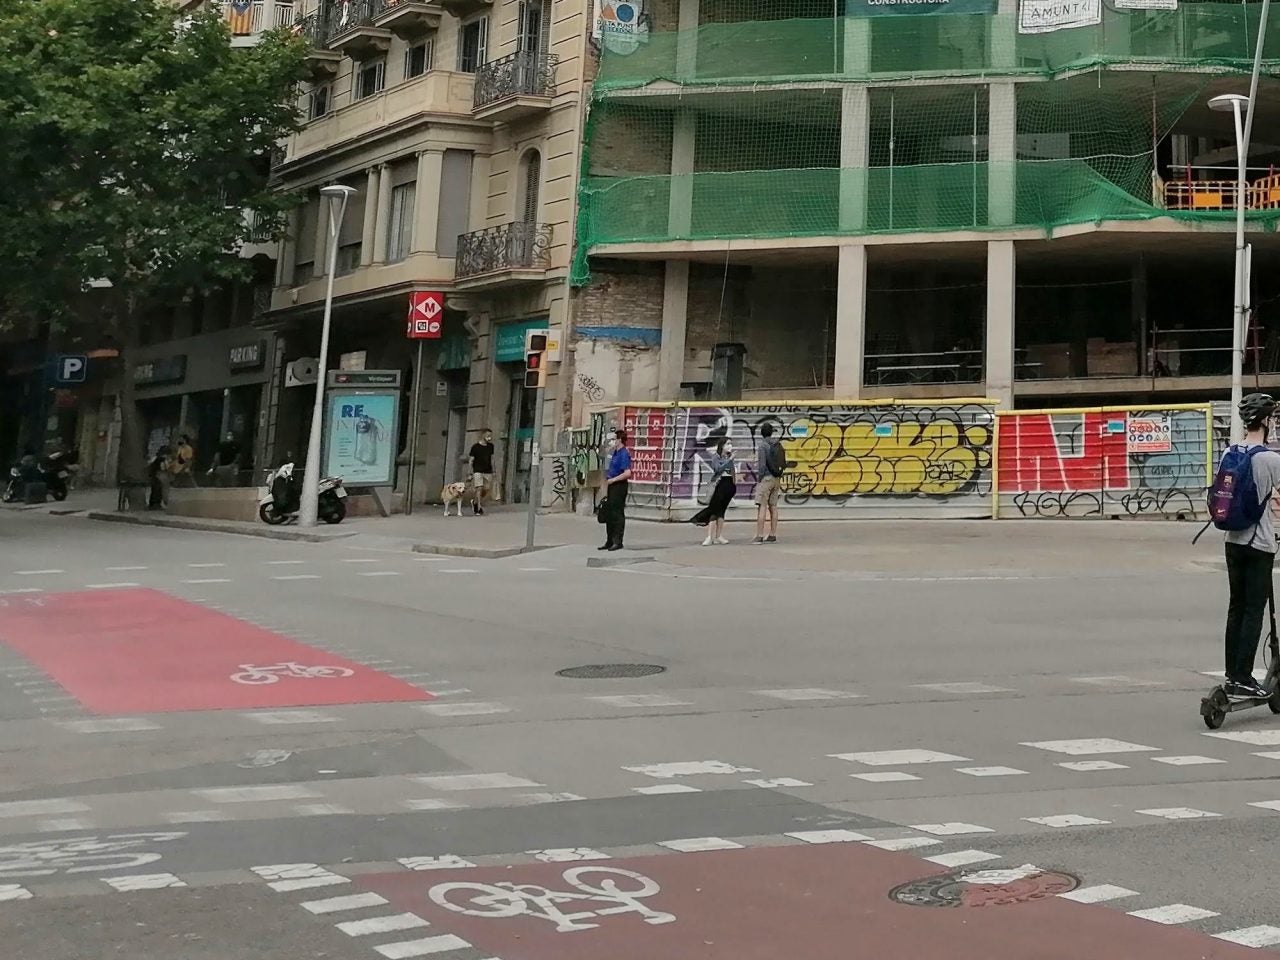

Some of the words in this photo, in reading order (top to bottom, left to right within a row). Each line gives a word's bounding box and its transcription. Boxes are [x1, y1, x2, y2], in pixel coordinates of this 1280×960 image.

[424, 302, 436, 314] M
[230, 345, 258, 363] PARKING
[63, 358, 83, 379] P
